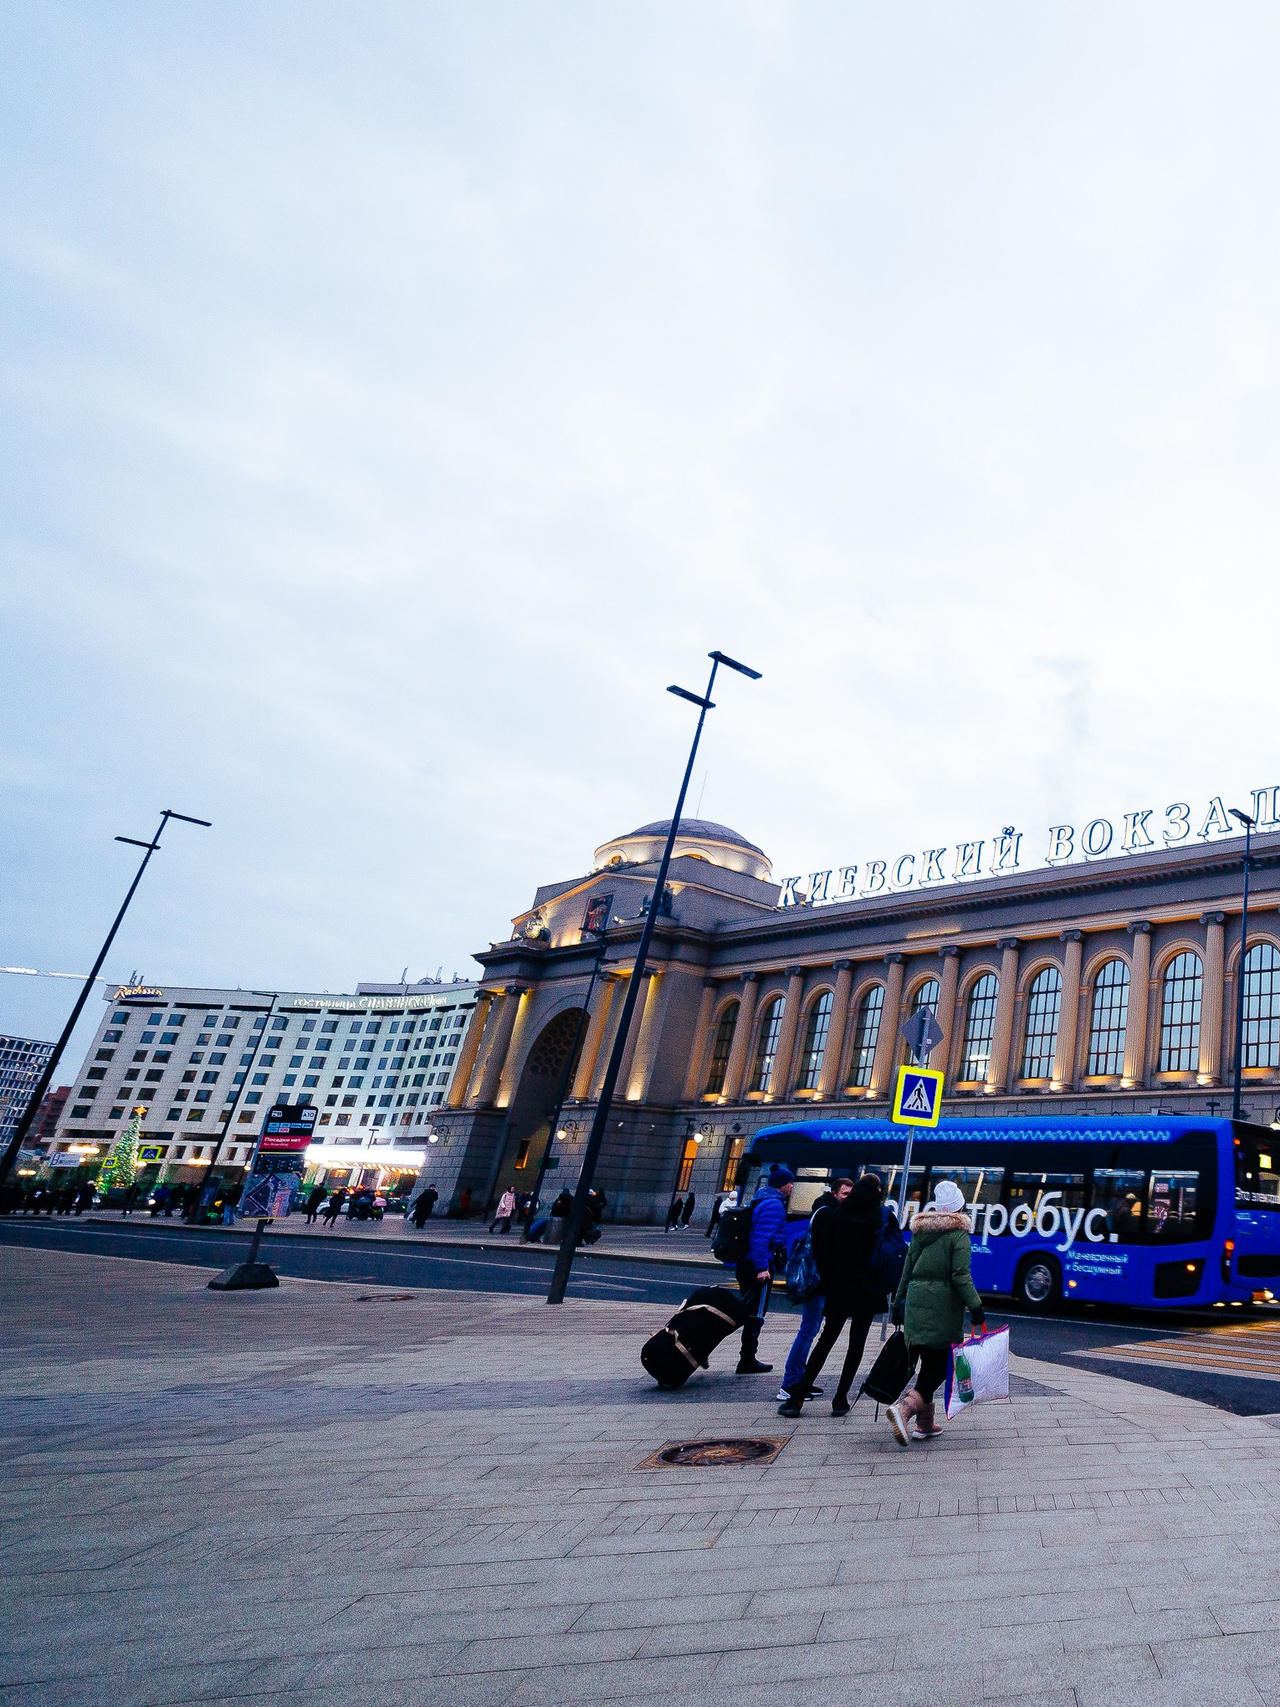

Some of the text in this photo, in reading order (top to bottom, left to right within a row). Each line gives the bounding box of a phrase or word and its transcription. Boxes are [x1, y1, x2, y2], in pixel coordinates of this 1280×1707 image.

[777, 786, 1280, 907] КИЕВСКИЙ ВОКЗАЛ
[884, 1191, 1118, 1251] лтробус.
